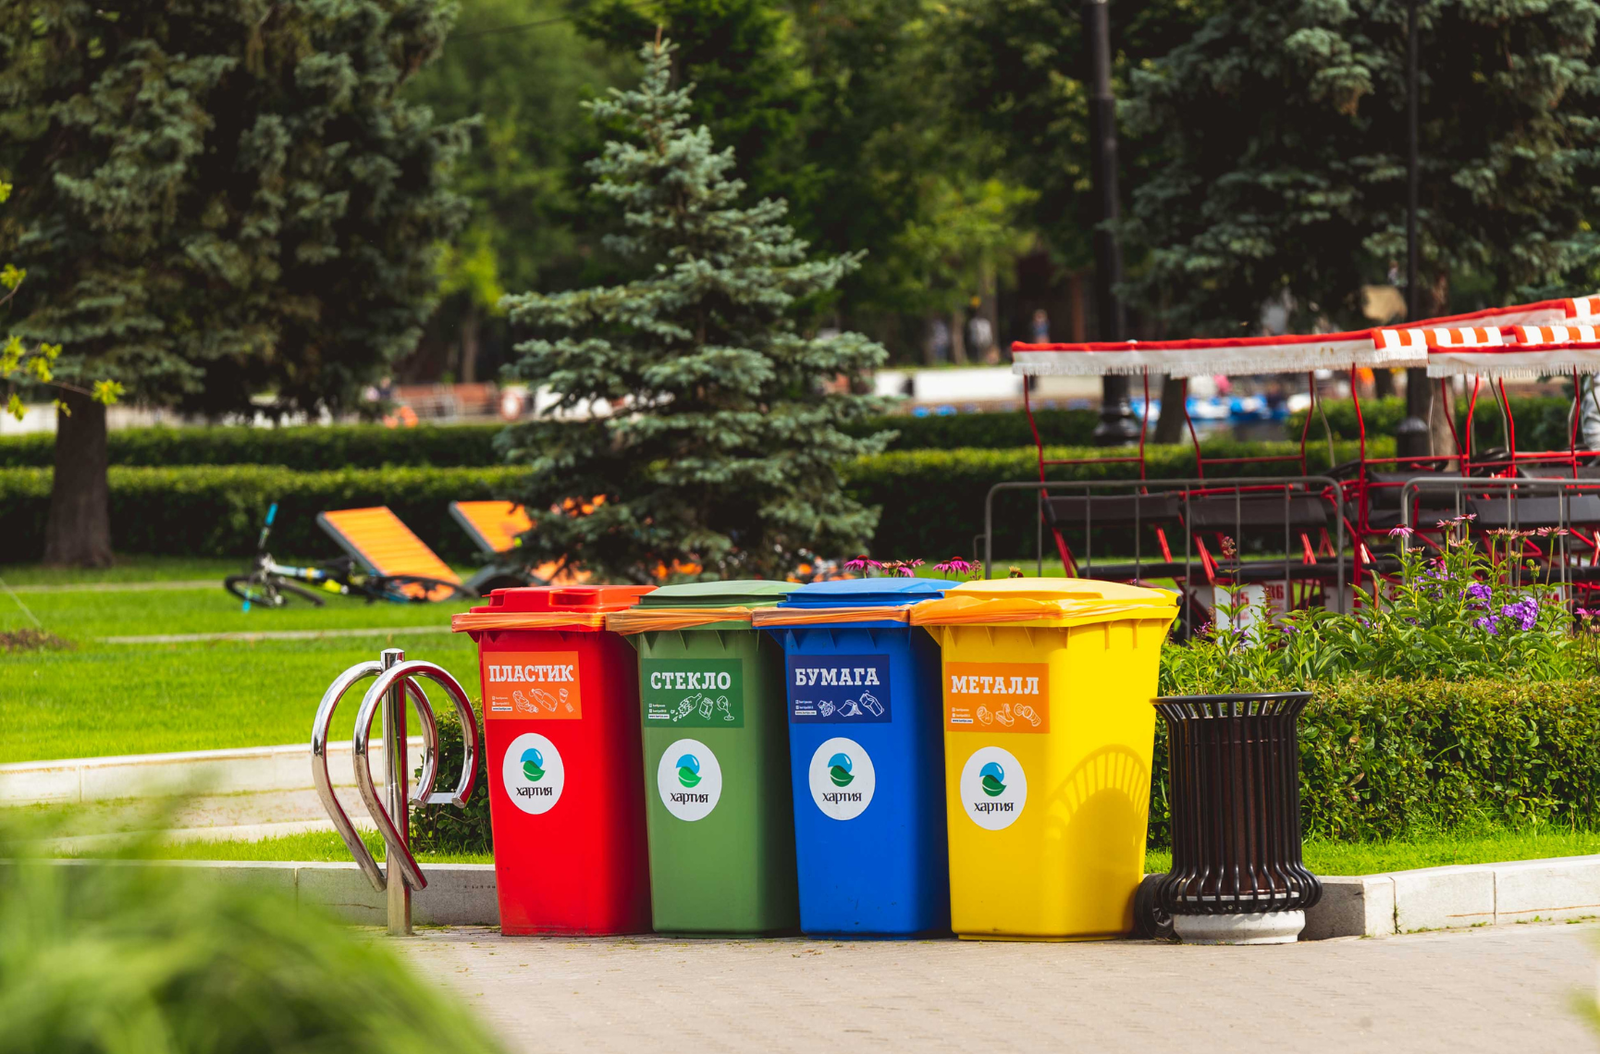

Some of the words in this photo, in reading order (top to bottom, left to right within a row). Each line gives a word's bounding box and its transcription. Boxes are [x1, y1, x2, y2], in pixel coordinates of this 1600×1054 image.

[488, 665, 575, 682] ПЛАСТИК
[650, 671, 731, 690] СТЕКЛО
[795, 667, 880, 686] БУМАГА
[951, 675, 1039, 695] МЕТАЛЛ
[516, 786, 553, 799] хартия
[670, 792, 709, 804] хартия
[822, 791, 862, 804] хартия
[974, 801, 1014, 815] хартия
